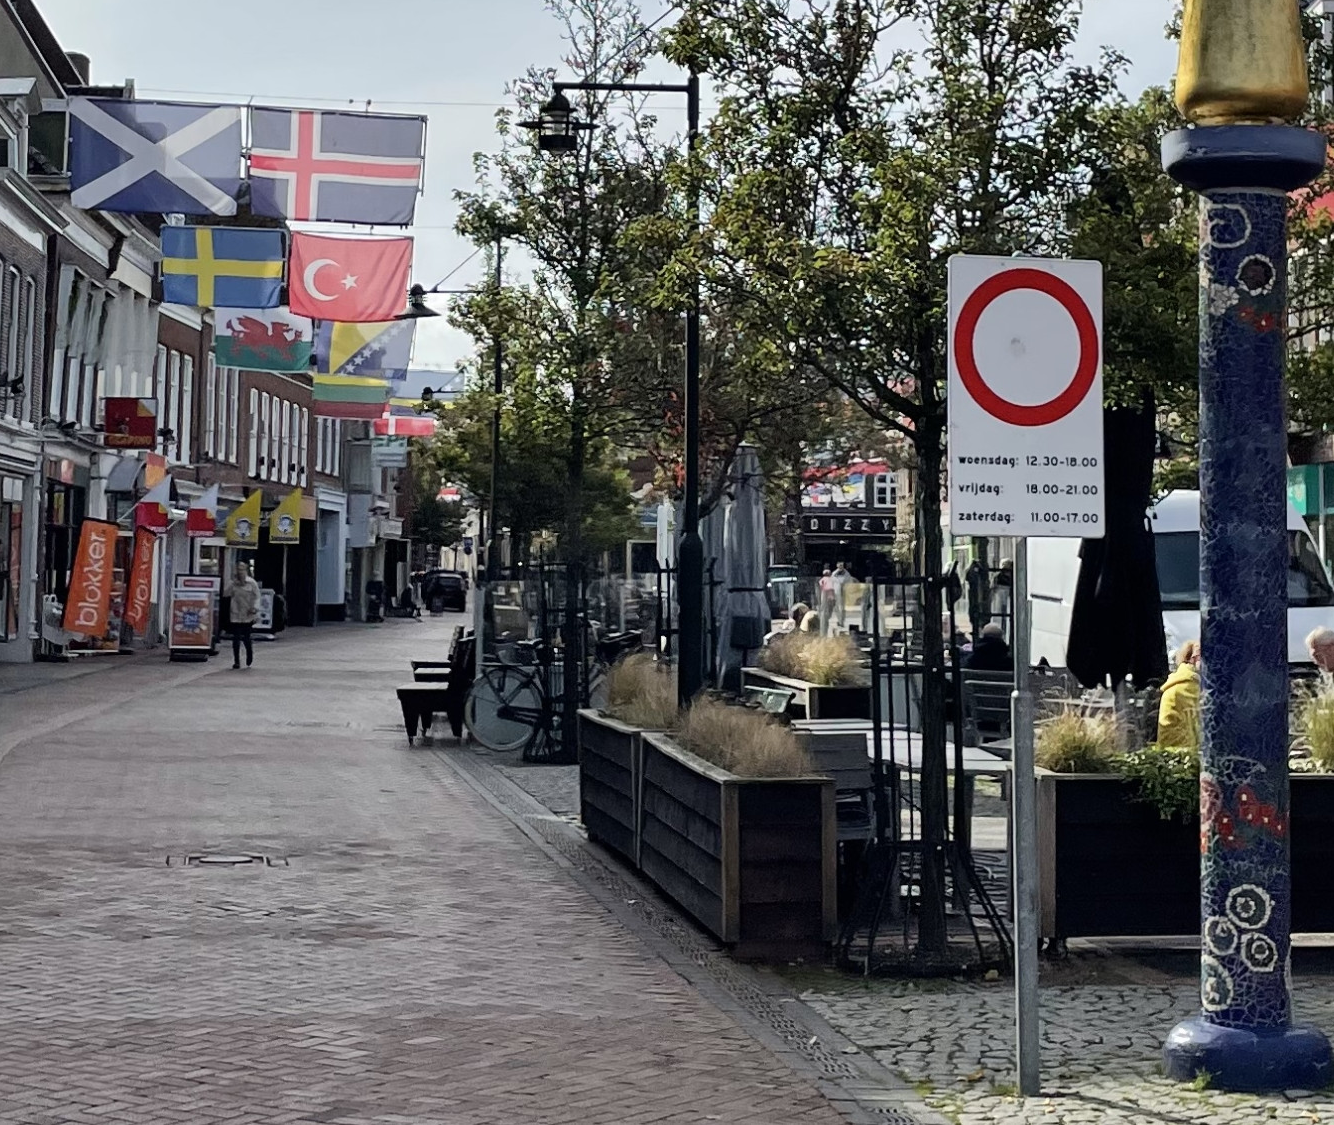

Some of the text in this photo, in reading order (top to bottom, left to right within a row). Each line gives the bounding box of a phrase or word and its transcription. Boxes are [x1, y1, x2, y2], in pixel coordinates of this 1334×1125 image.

[958, 455, 1098, 468] woensdag: 12.30-18.00
[958, 482, 1098, 496] vrijdag: 18.00-21.00
[958, 511, 1099, 524] zaterdag: 11.00-17.00
[810, 518, 890, 531] DIZZY
[75, 532, 107, 627] blokker
